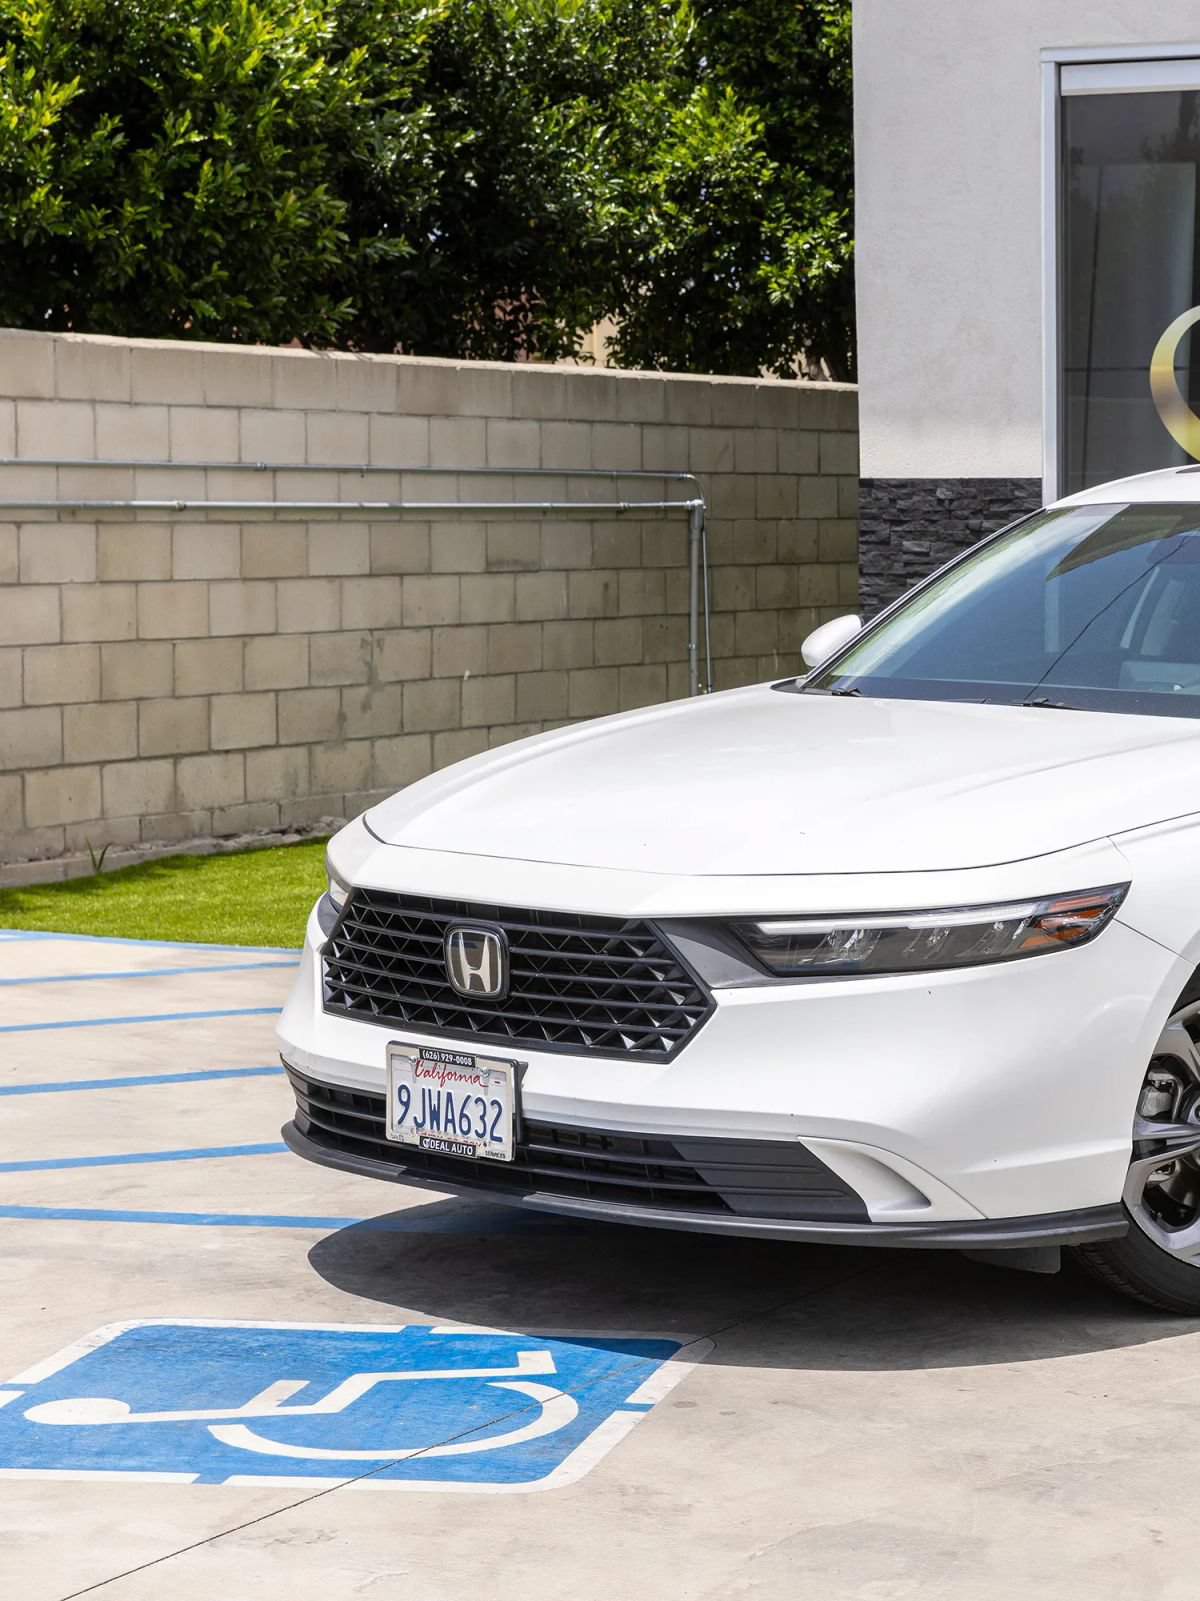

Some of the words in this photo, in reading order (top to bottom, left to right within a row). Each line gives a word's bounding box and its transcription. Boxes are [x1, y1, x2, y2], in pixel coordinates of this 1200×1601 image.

[422, 1049, 440, 1061] (626)
[440, 1052, 473, 1066] 929-0008
[414, 1058, 489, 1088] California
[397, 1084, 503, 1143] 9JWA632
[451, 1142, 474, 1156] AUTO
